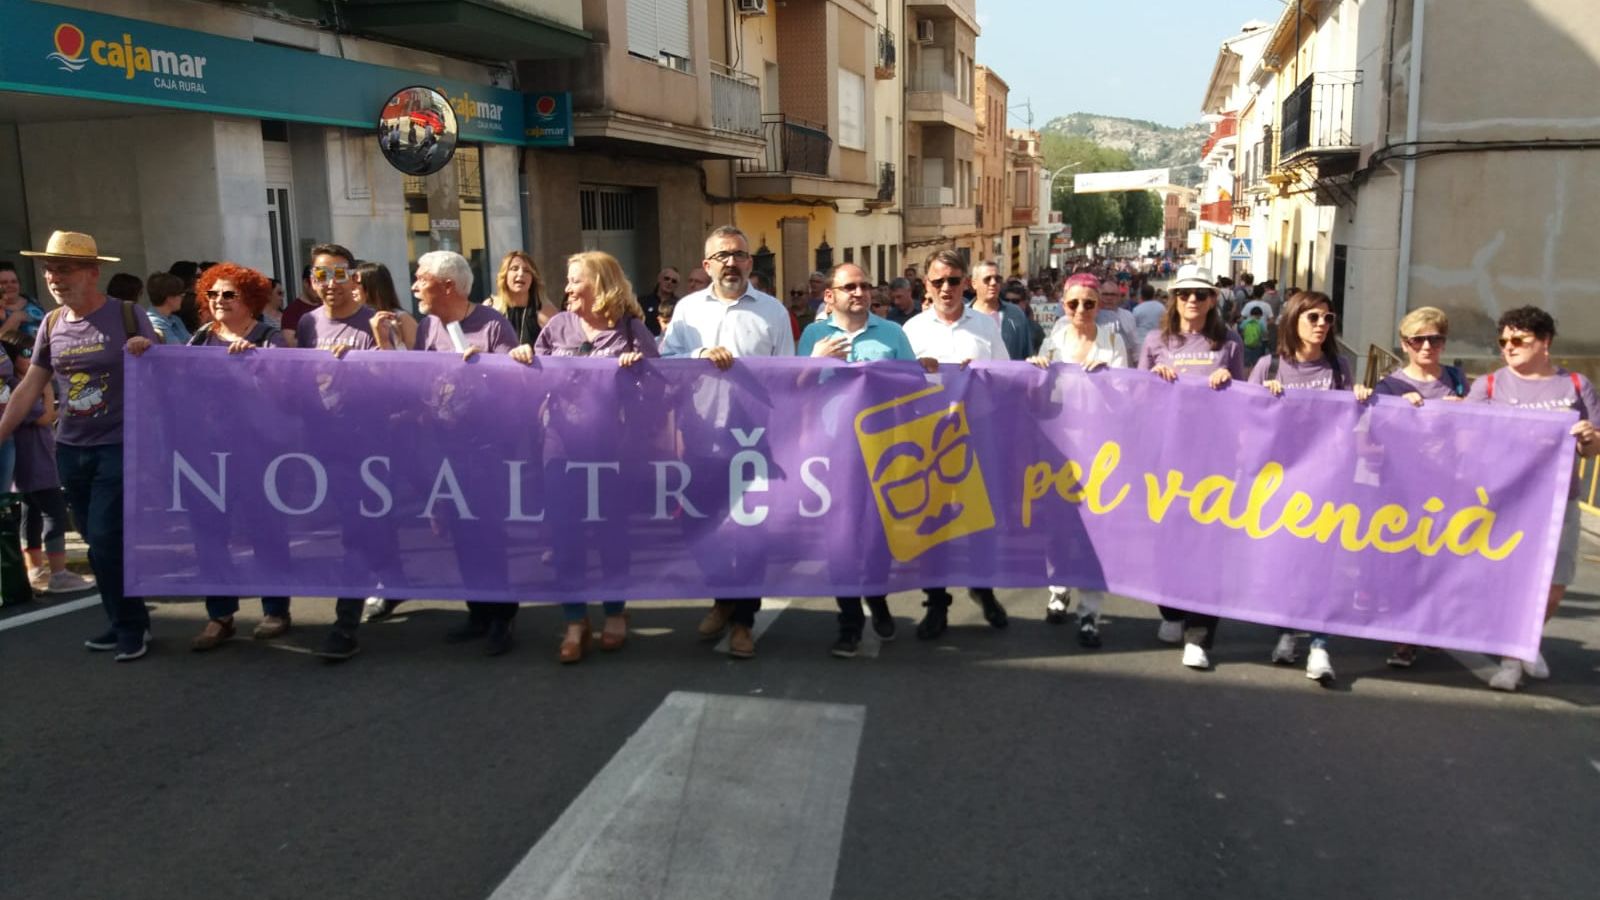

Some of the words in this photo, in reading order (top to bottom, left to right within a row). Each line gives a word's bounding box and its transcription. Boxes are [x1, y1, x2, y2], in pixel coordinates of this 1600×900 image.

[90, 33, 207, 80] cajamar
[154, 77, 177, 89] CAJA
[179, 82, 207, 94] RURAL
[525, 125, 566, 138] cajamar
[1022, 441, 1131, 528] pel
[1144, 462, 1524, 560] valencià
